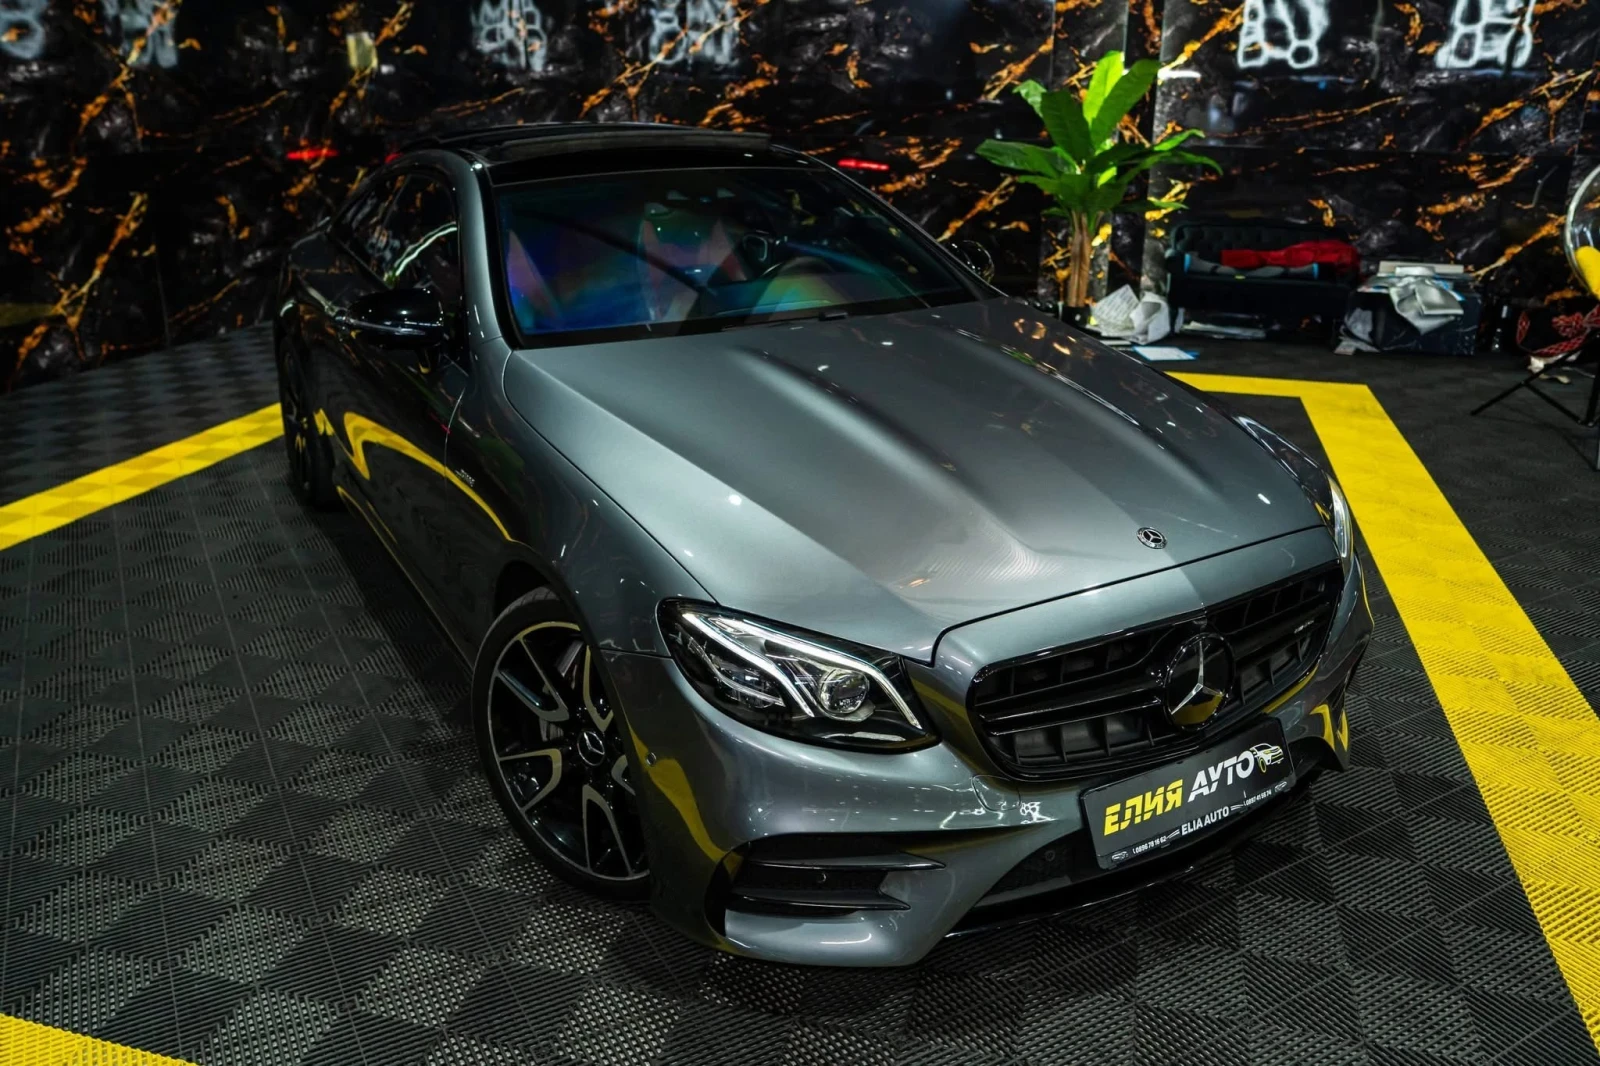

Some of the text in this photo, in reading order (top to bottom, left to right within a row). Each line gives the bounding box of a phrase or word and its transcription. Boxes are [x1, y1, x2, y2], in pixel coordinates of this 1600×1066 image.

[1104, 750, 1254, 836] ЕЛИЯ АУТО
[1181, 806, 1230, 836] ELIA AUTO
